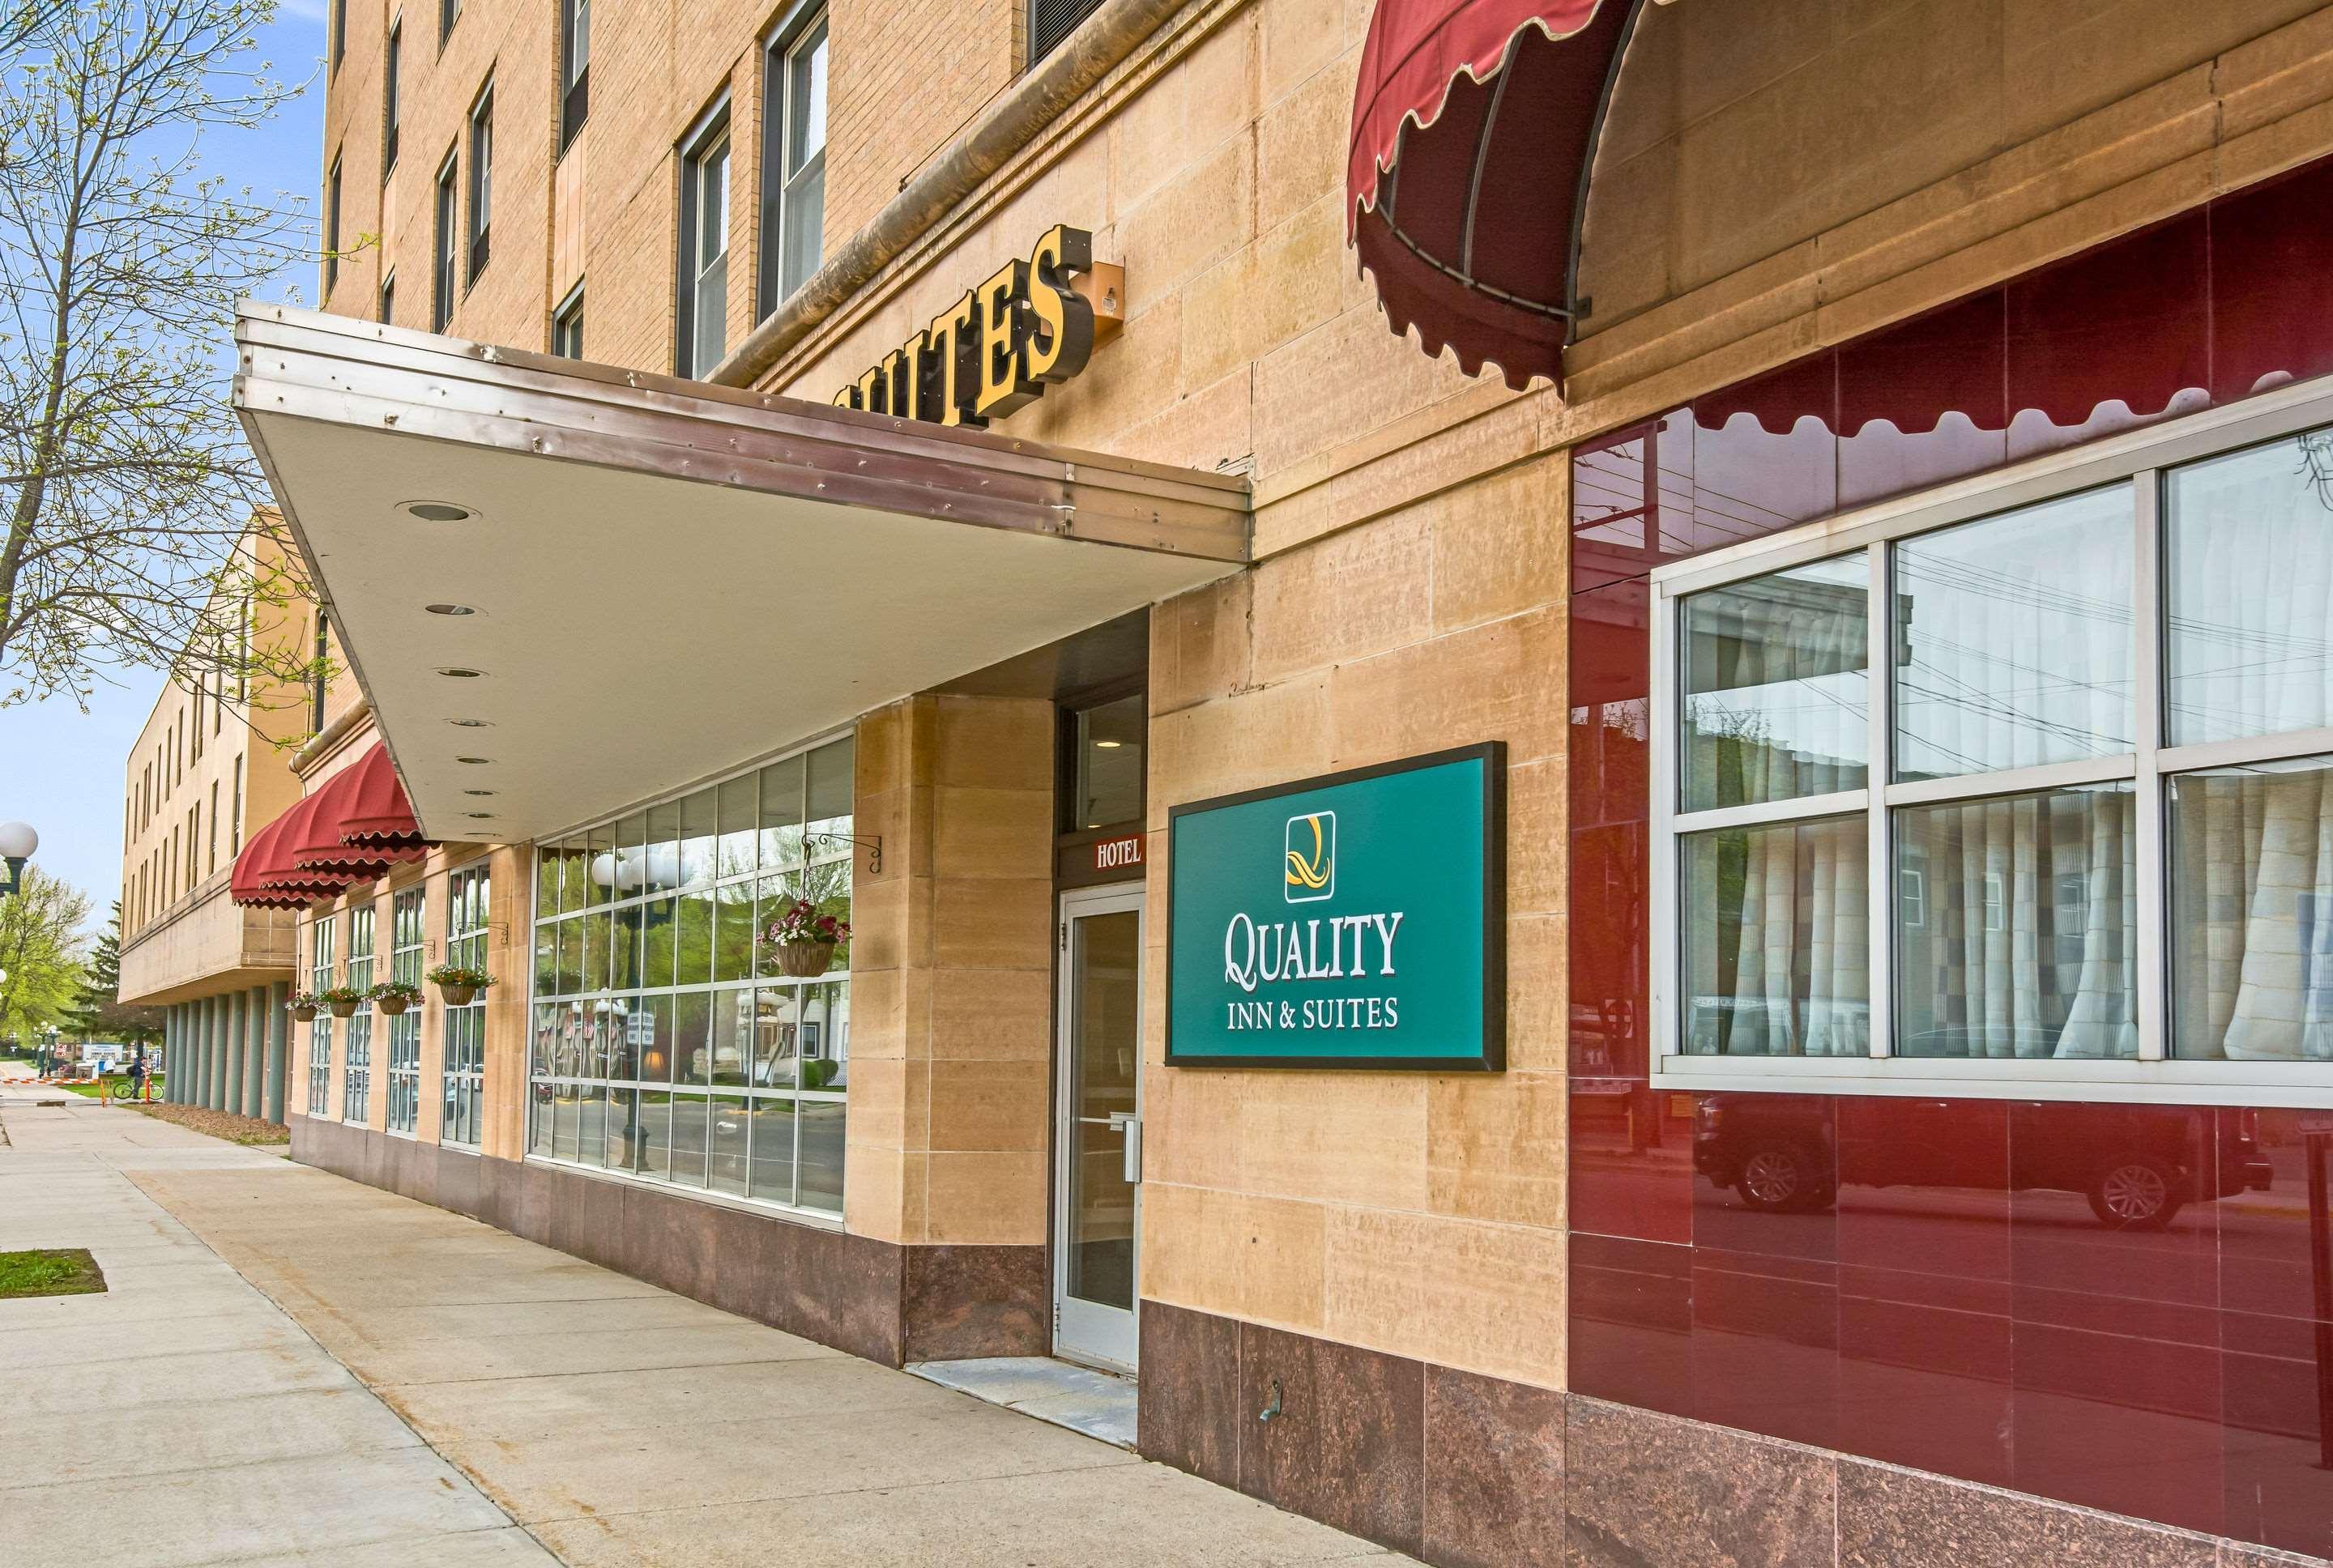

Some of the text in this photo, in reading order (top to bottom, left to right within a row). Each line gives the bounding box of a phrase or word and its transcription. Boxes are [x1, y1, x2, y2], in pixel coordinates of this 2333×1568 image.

[1097, 838, 1141, 868] HOTEL
[1225, 911, 1404, 992] QUALITY
[1226, 996, 1399, 1029] INN & SUITES
